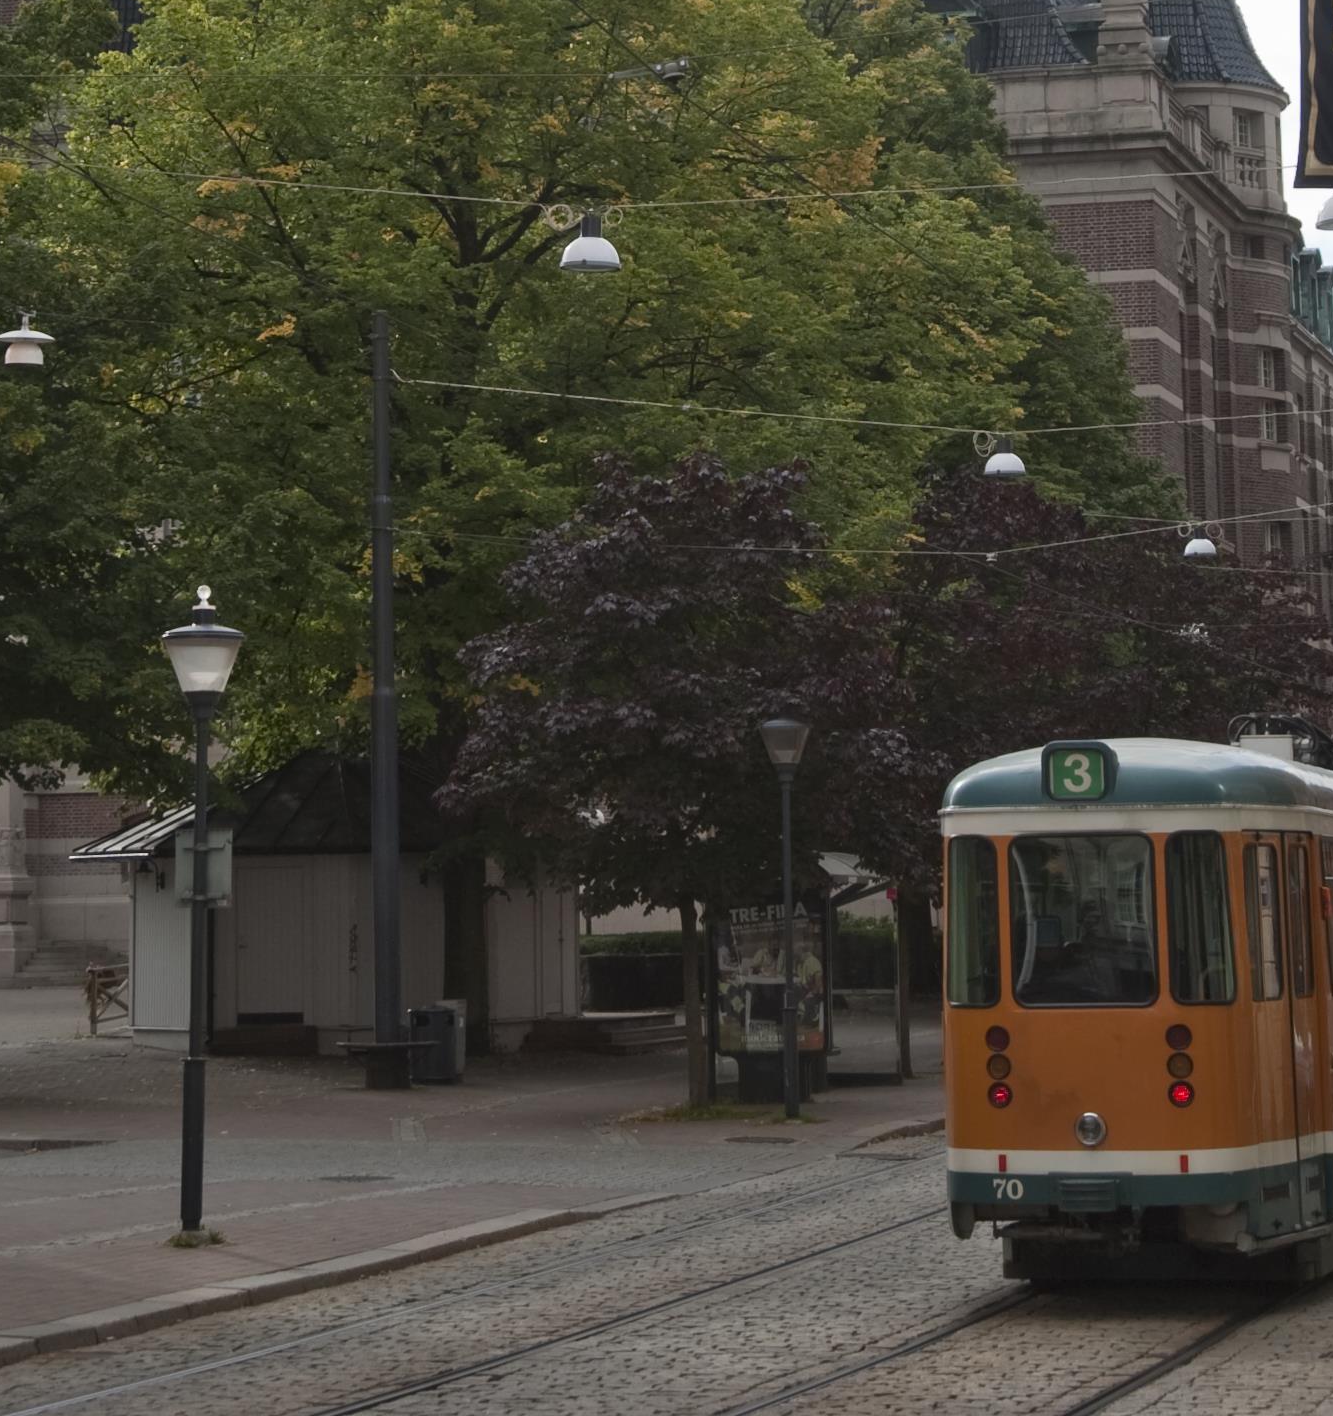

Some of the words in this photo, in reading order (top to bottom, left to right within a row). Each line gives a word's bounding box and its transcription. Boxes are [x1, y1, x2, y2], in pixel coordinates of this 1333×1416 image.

[1063, 754, 1092, 793] 3
[729, 901, 808, 924] TRE-FIA
[993, 1178, 1024, 1200] 70
